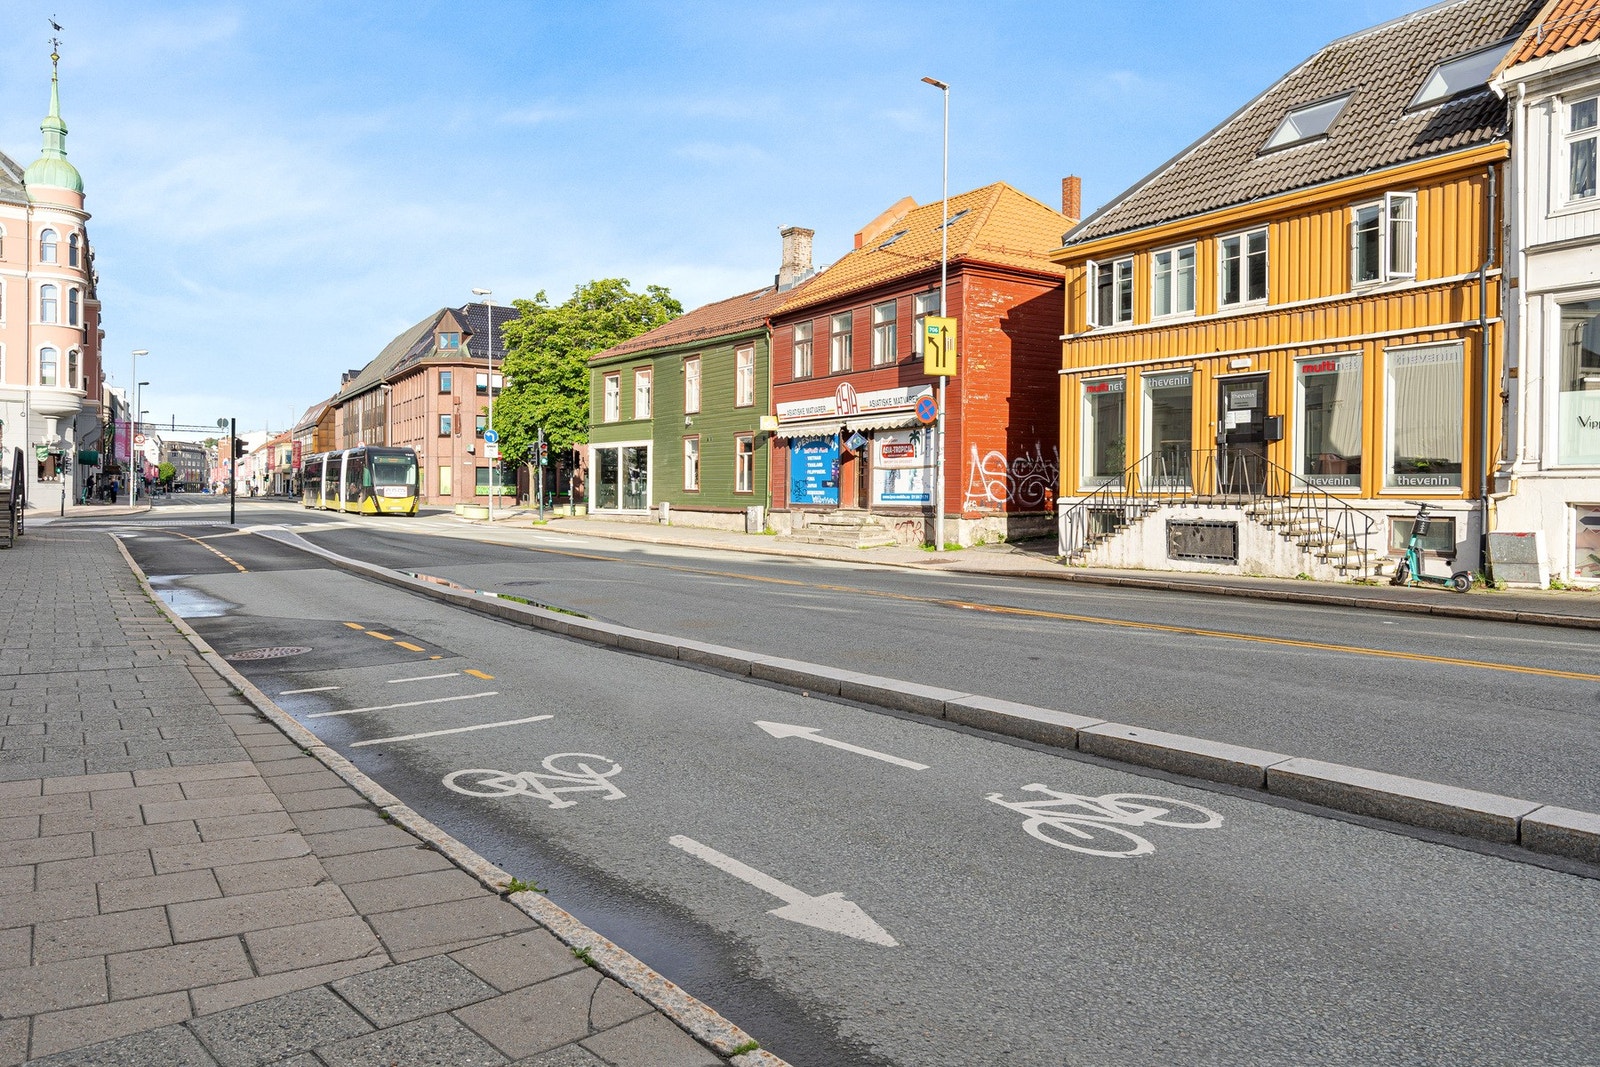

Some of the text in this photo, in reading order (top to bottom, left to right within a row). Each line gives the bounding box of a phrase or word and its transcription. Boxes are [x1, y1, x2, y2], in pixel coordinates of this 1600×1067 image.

[1148, 375, 1190, 388] thevenin
[836, 383, 858, 416] ASIA
[869, 398, 893, 408] ASIATISKE
[786, 407, 805, 416] ASIATISKE
[1576, 415, 1600, 430] Vip
[1397, 475, 1450, 486] thevenin
